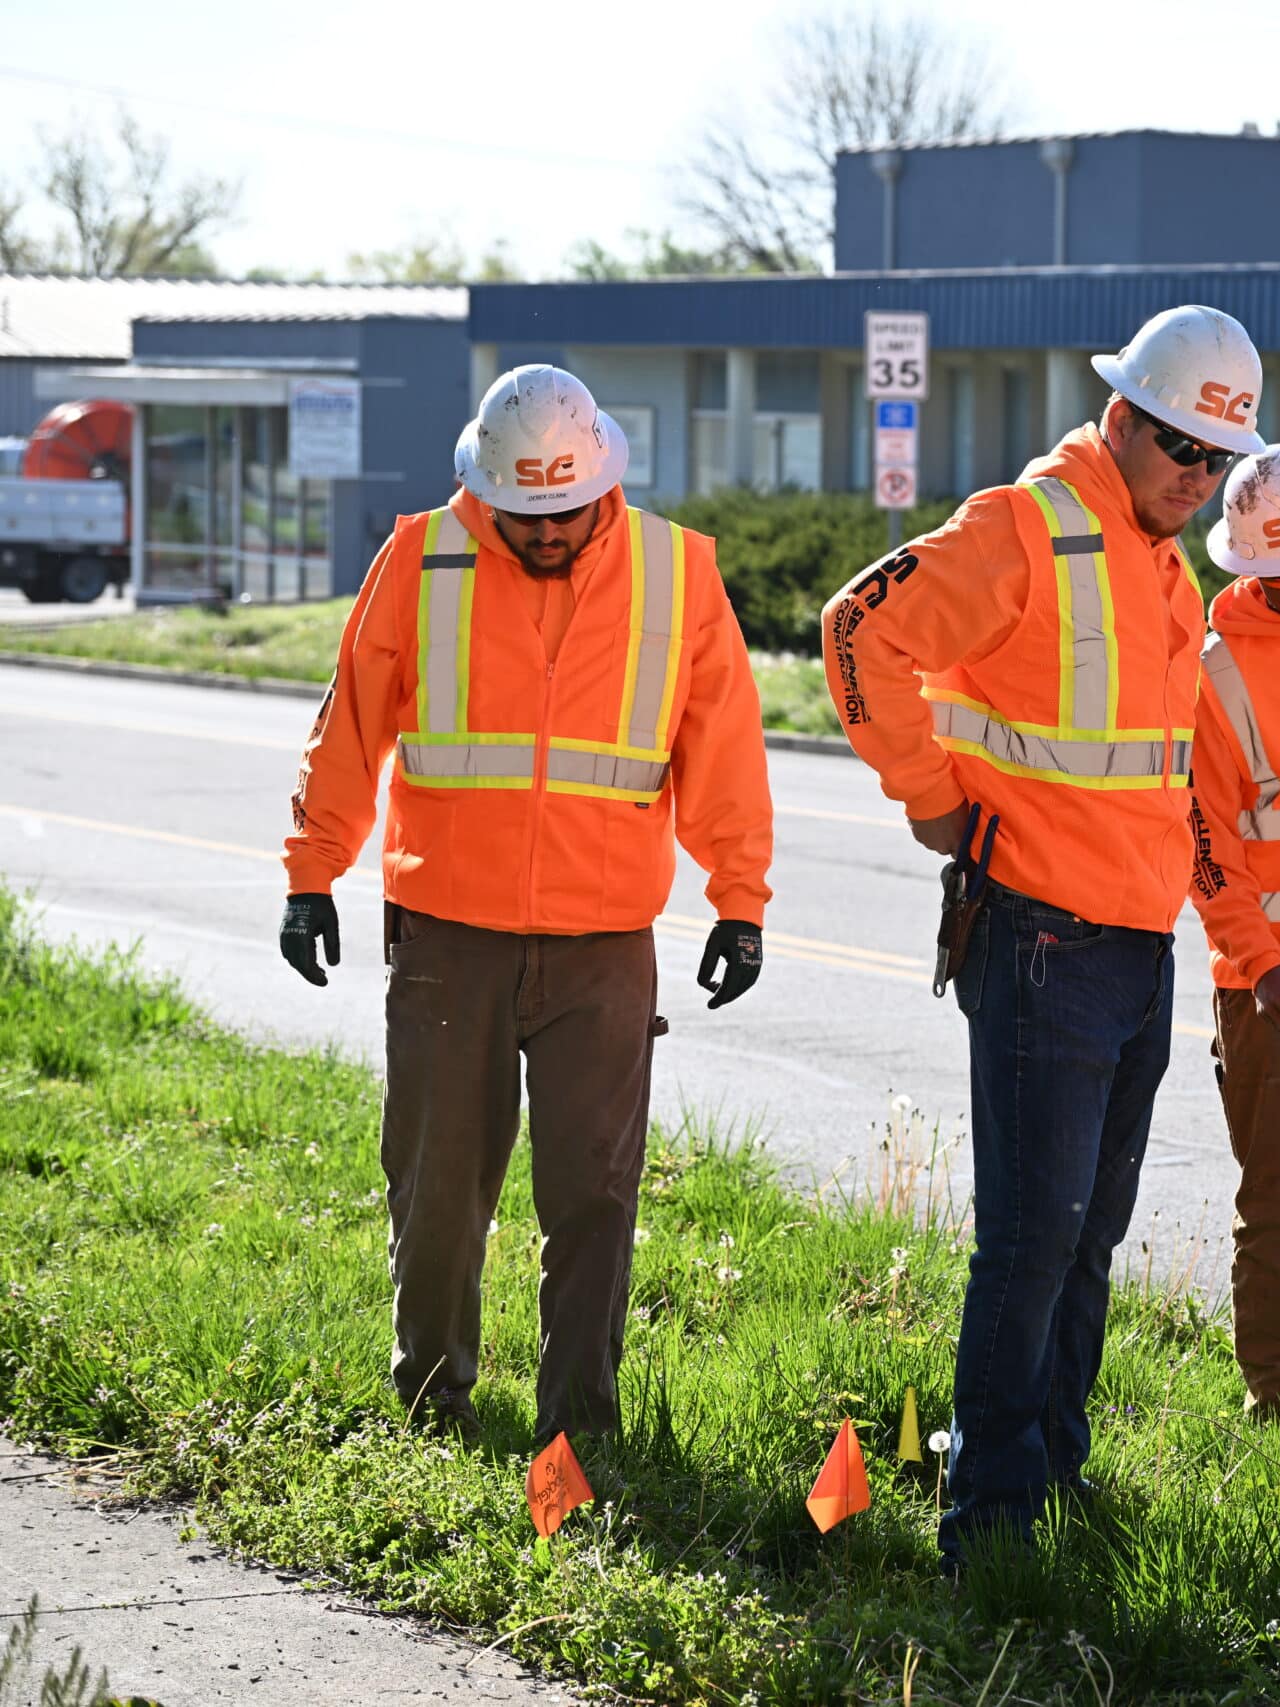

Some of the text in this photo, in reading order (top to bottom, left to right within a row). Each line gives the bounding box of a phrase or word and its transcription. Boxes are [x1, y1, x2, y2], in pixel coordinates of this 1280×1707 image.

[873, 322, 920, 335] SPEED
[878, 340, 915, 353] LIMIT
[874, 358, 920, 389] 35
[1195, 381, 1254, 425] SC
[515, 453, 576, 487] SC
